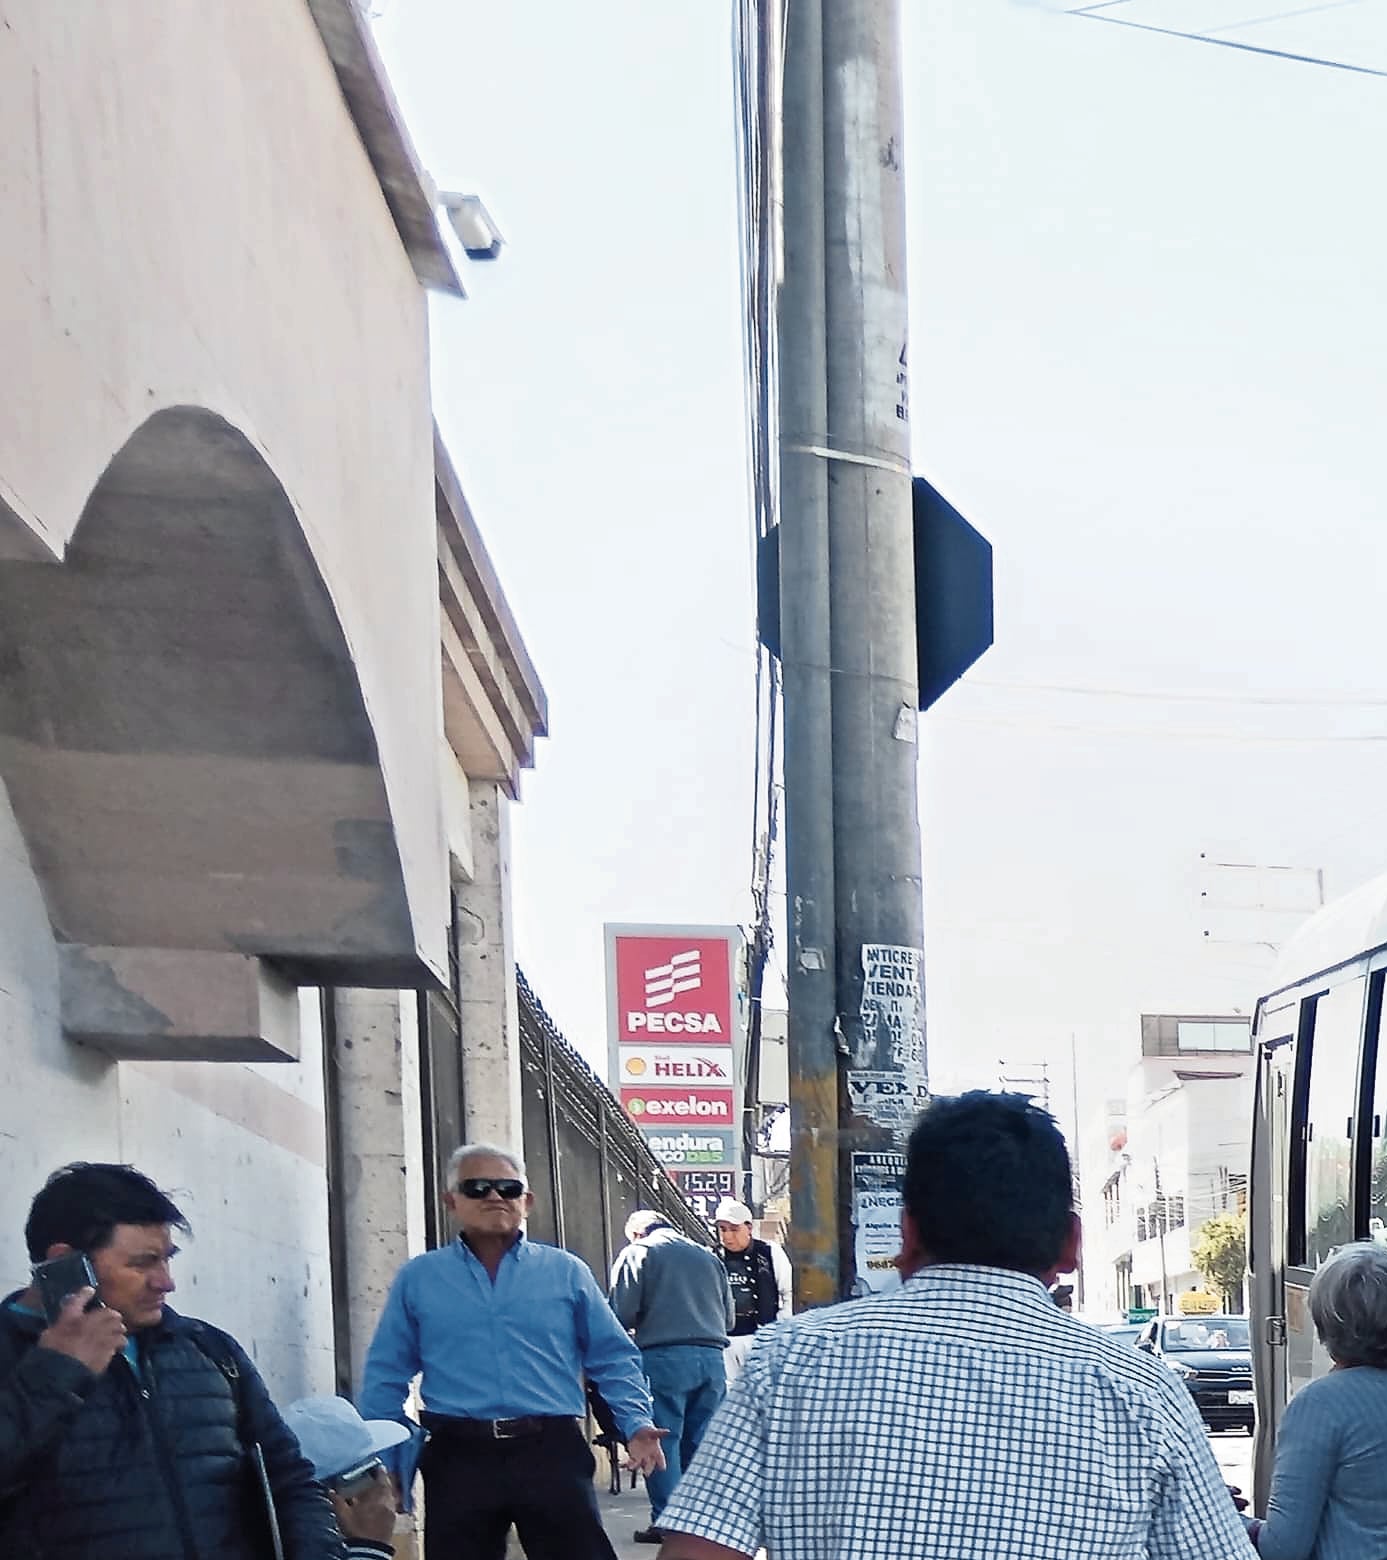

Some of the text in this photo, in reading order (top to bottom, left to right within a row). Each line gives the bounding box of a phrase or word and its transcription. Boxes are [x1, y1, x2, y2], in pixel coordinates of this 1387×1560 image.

[627, 1011, 722, 1033] PECSA
[655, 1061, 723, 1078] HELIX
[646, 1096, 728, 1116] exelon
[648, 1133, 724, 1152] endura
